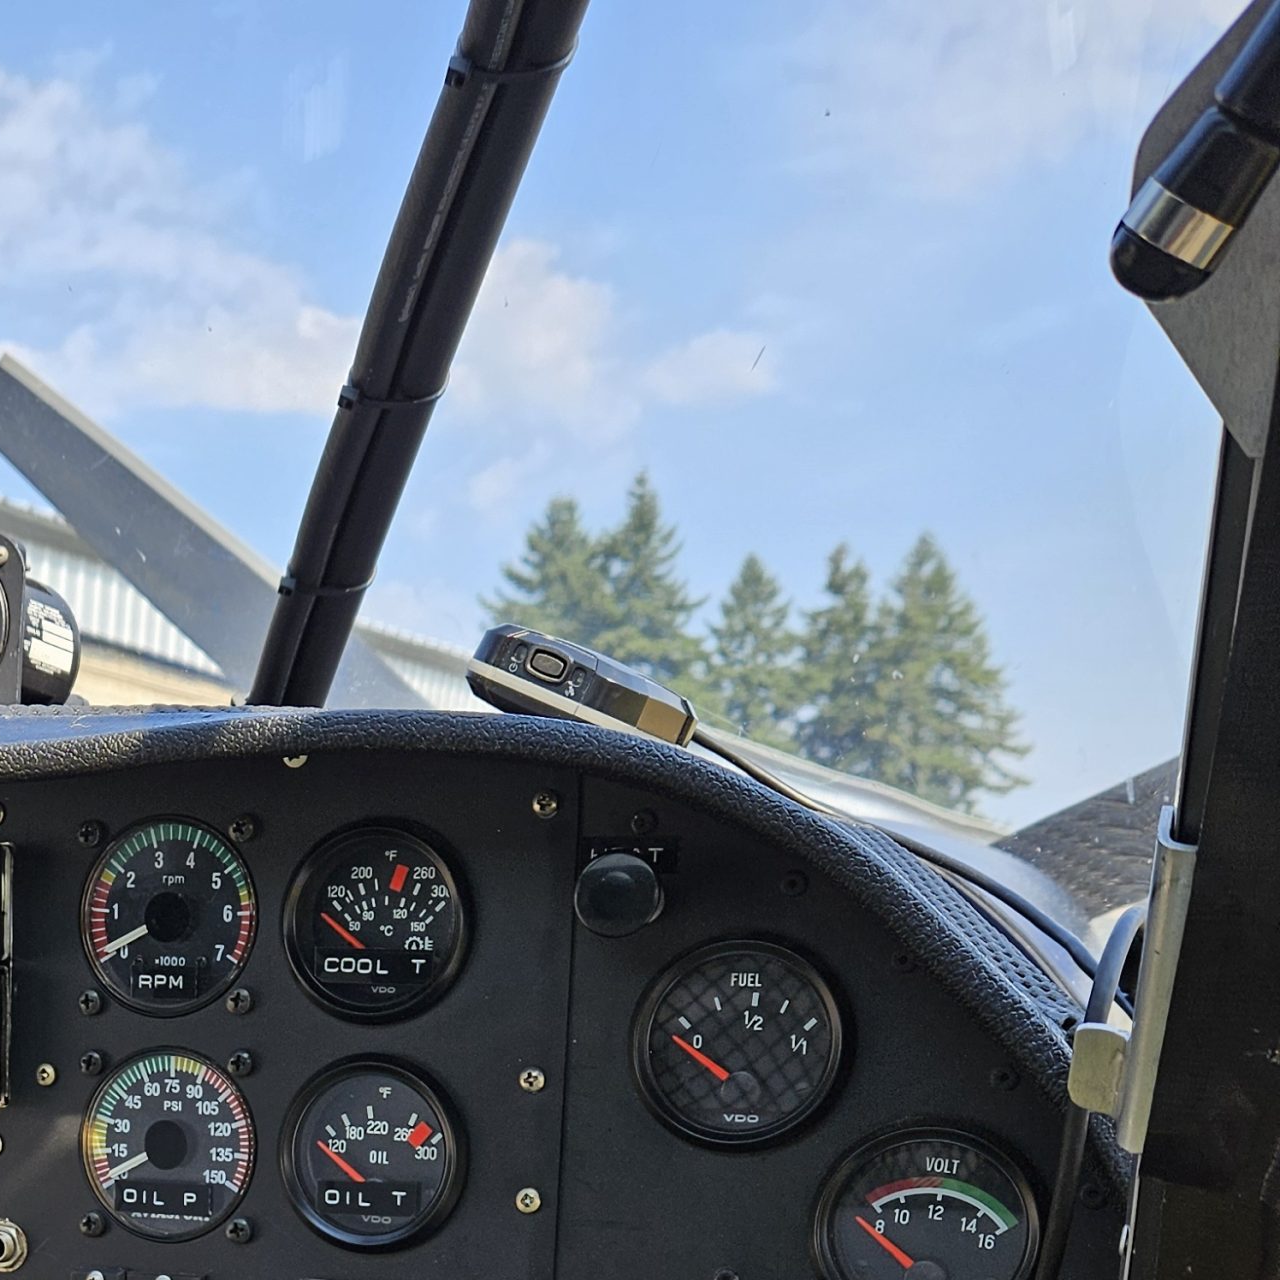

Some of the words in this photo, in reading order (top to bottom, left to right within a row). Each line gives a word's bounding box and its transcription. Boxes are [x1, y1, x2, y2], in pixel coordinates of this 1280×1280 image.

[154, 852, 164, 869] 3
[186, 852, 195, 869] 4
[351, 866, 373, 879] 200
[413, 866, 436, 880] 260
[126, 872, 136, 888] 2
[162, 875, 185, 887] rpm
[211, 873, 221, 890] 5
[327, 886, 346, 898] 120
[113, 903, 119, 920] 1
[223, 905, 233, 922] 6
[362, 911, 375, 921] 90
[393, 909, 408, 919] 120
[349, 921, 361, 931] 50
[410, 922, 426, 932] 150
[120, 945, 129, 959] 0
[214, 945, 225, 961] 7
[324, 957, 389, 975] COOL
[411, 959, 426, 974] T
[138, 975, 183, 989] RPM
[730, 973, 762, 987] FUEL
[371, 986, 396, 994] VDO
[692, 1035, 703, 1049] 0
[144, 1083, 160, 1096] 60
[164, 1079, 180, 1093] 75
[186, 1085, 203, 1099] 90
[125, 1096, 142, 1110] 45
[163, 1101, 182, 1112] PSI
[195, 1101, 219, 1115] 105
[723, 1113, 759, 1123] VDO
[114, 1120, 130, 1133] 30
[208, 1122, 231, 1136] 120
[345, 1127, 364, 1140] 180
[366, 1121, 389, 1135] 220
[112, 1144, 128, 1157] 15
[328, 1140, 346, 1153] 120
[415, 1146, 437, 1160] 300
[210, 1148, 233, 1162] 135
[369, 1151, 389, 1164] OIL
[925, 1156, 960, 1175] VOLT
[203, 1170, 226, 1184] 150
[123, 1188, 165, 1206] OIL
[184, 1193, 197, 1206] P
[325, 1190, 371, 1207] OIL
[392, 1191, 407, 1206] T
[362, 1215, 392, 1224] VDO
[894, 1209, 910, 1225] 10
[928, 1205, 945, 1221] 12
[875, 1219, 885, 1234] 8
[960, 1217, 977, 1234] 14
[978, 1233, 995, 1250] 16
